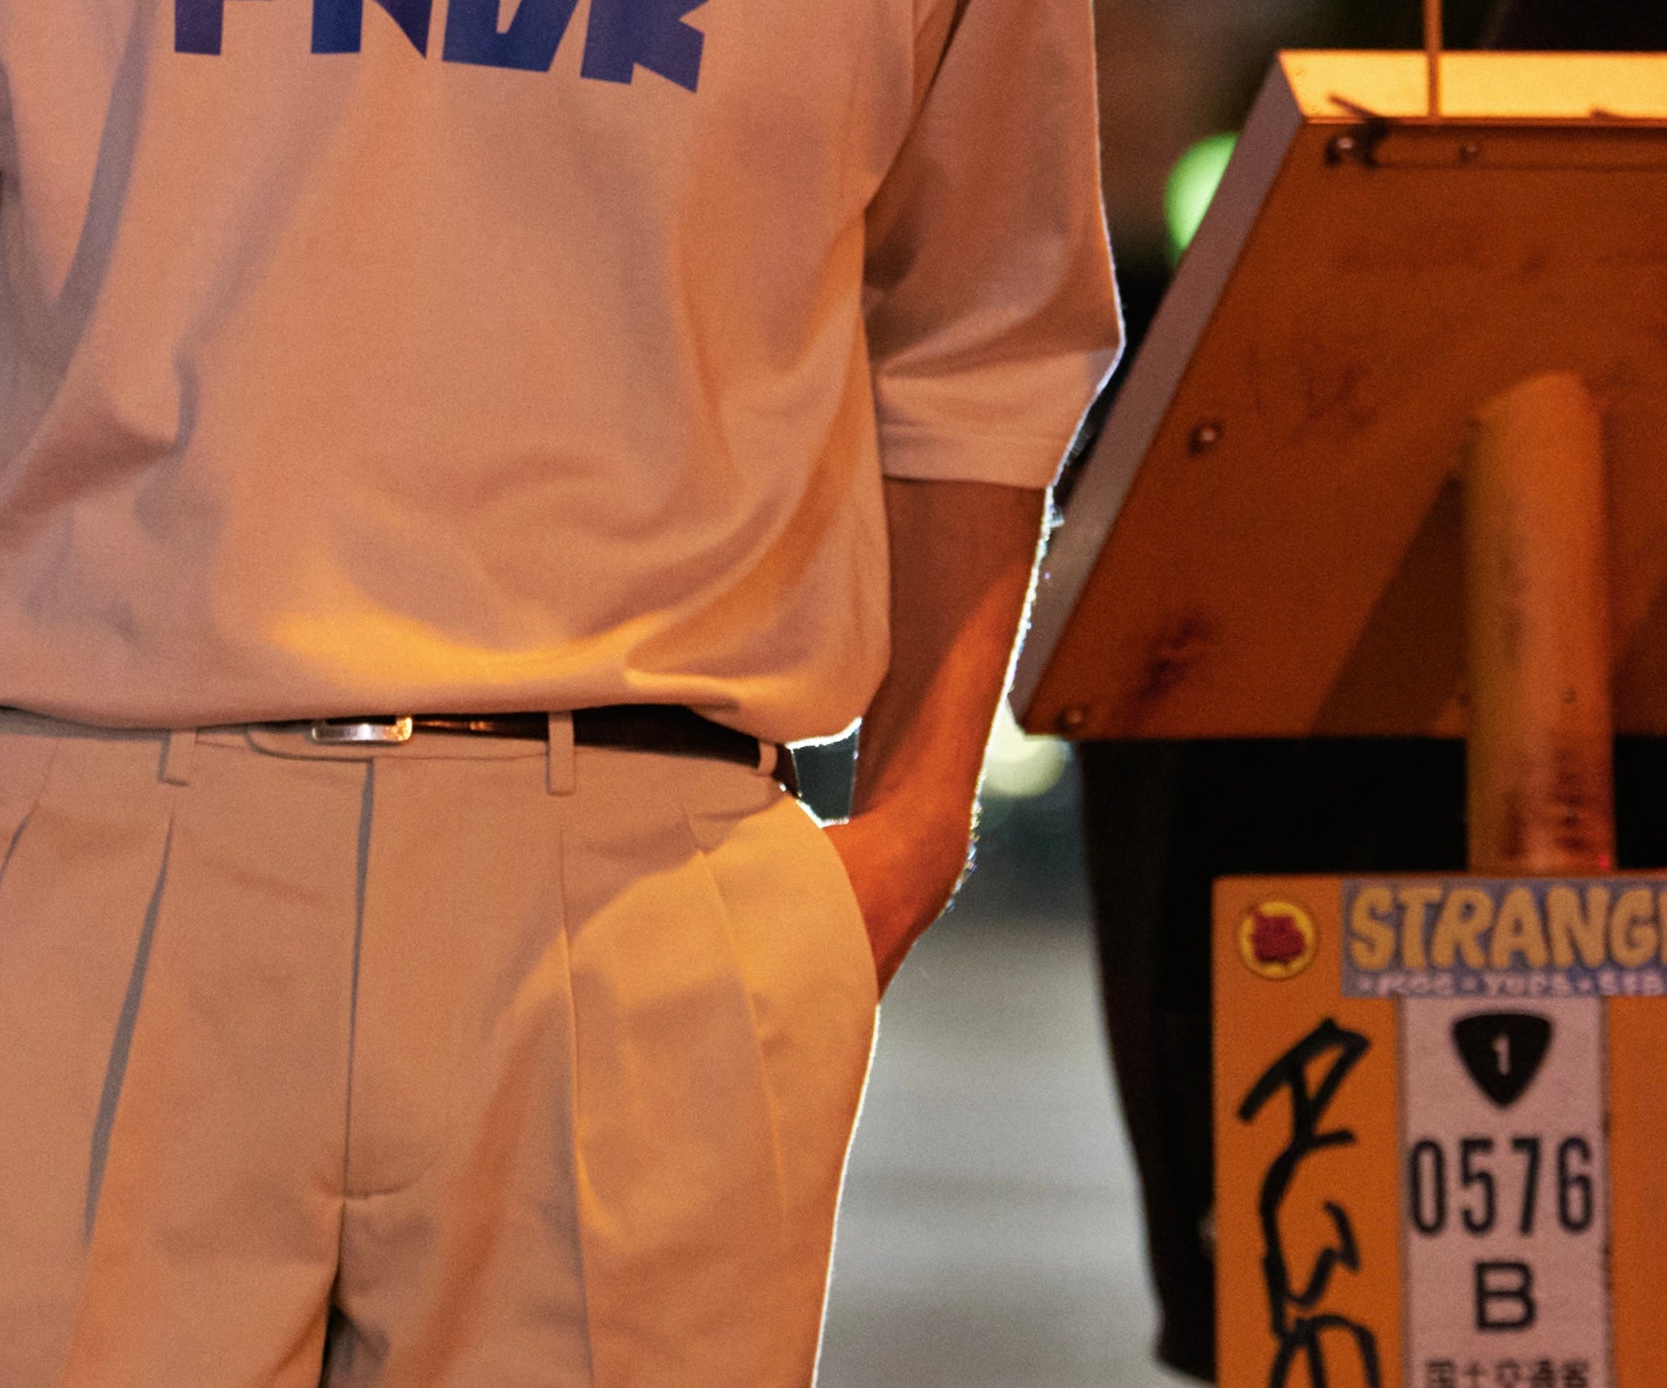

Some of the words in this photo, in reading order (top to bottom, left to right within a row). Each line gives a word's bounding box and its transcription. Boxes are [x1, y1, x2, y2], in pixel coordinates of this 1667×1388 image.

[1349, 885, 1667, 969] STRANG
[1492, 1034, 1511, 1077] 1
[1409, 1136, 1593, 1238] 0576
[1475, 1260, 1536, 1331] B
